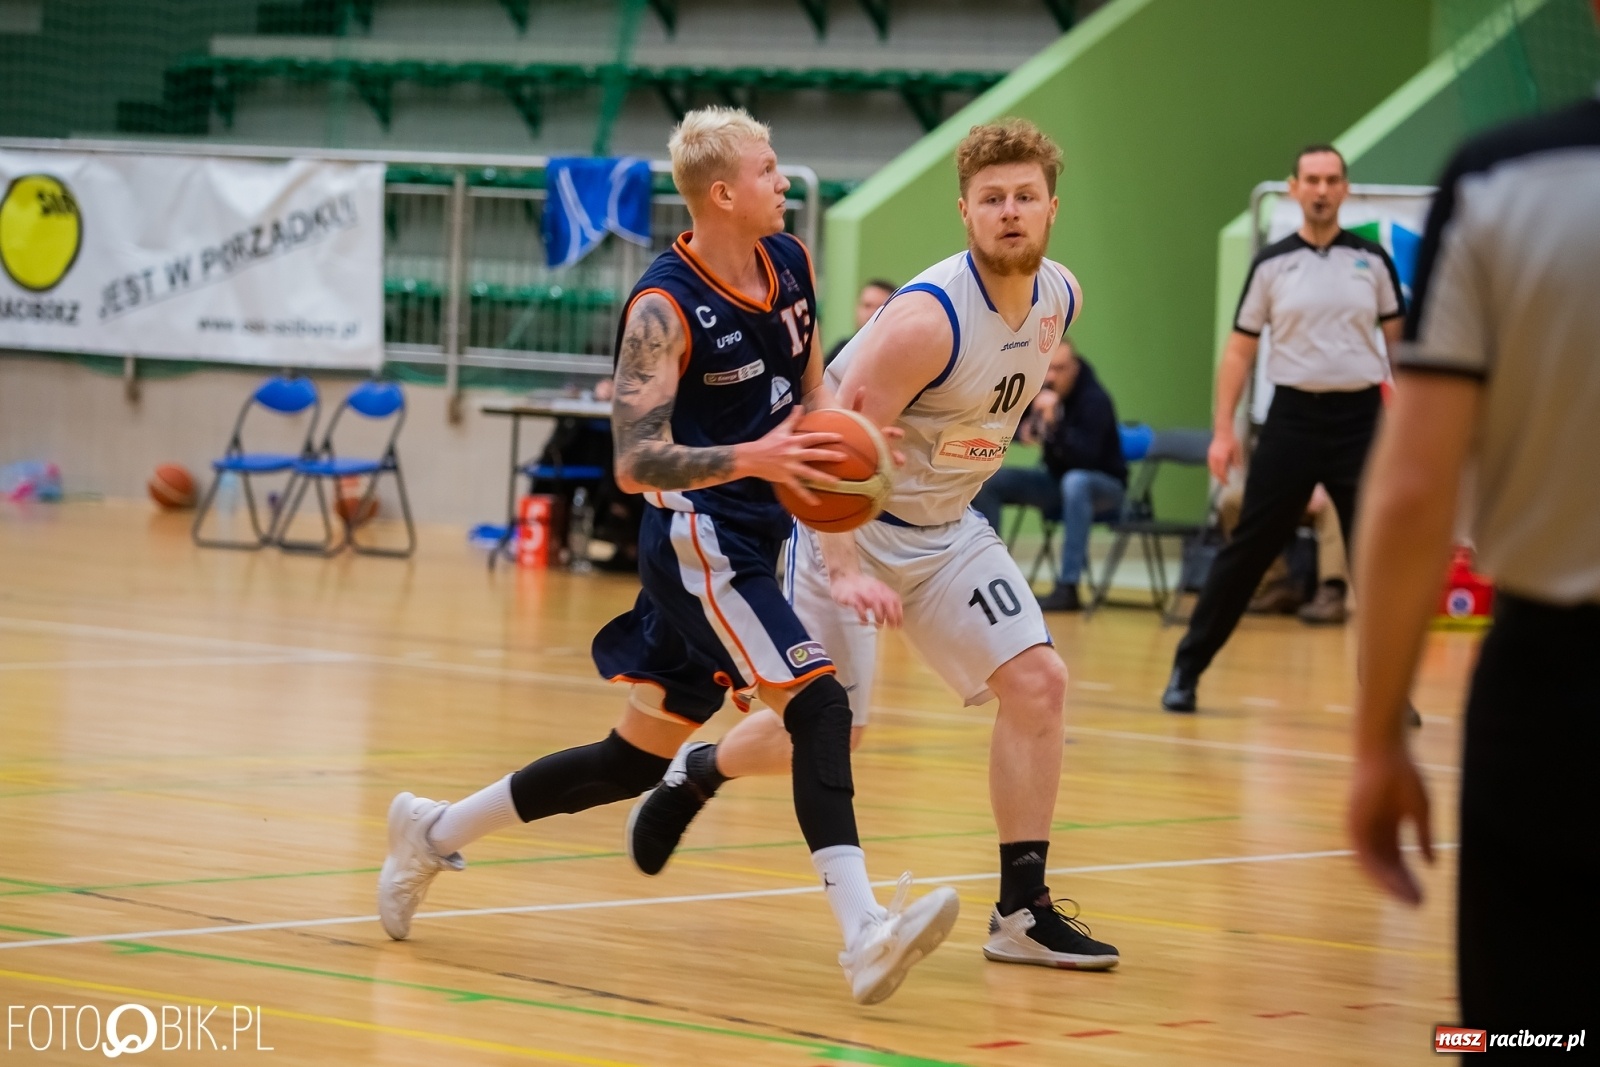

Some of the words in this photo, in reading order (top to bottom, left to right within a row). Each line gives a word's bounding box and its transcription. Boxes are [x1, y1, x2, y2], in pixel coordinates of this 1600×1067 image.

[164, 254, 192, 290] W
[695, 305, 717, 329] C
[989, 373, 1026, 414] 10
[968, 578, 1022, 626] 10
